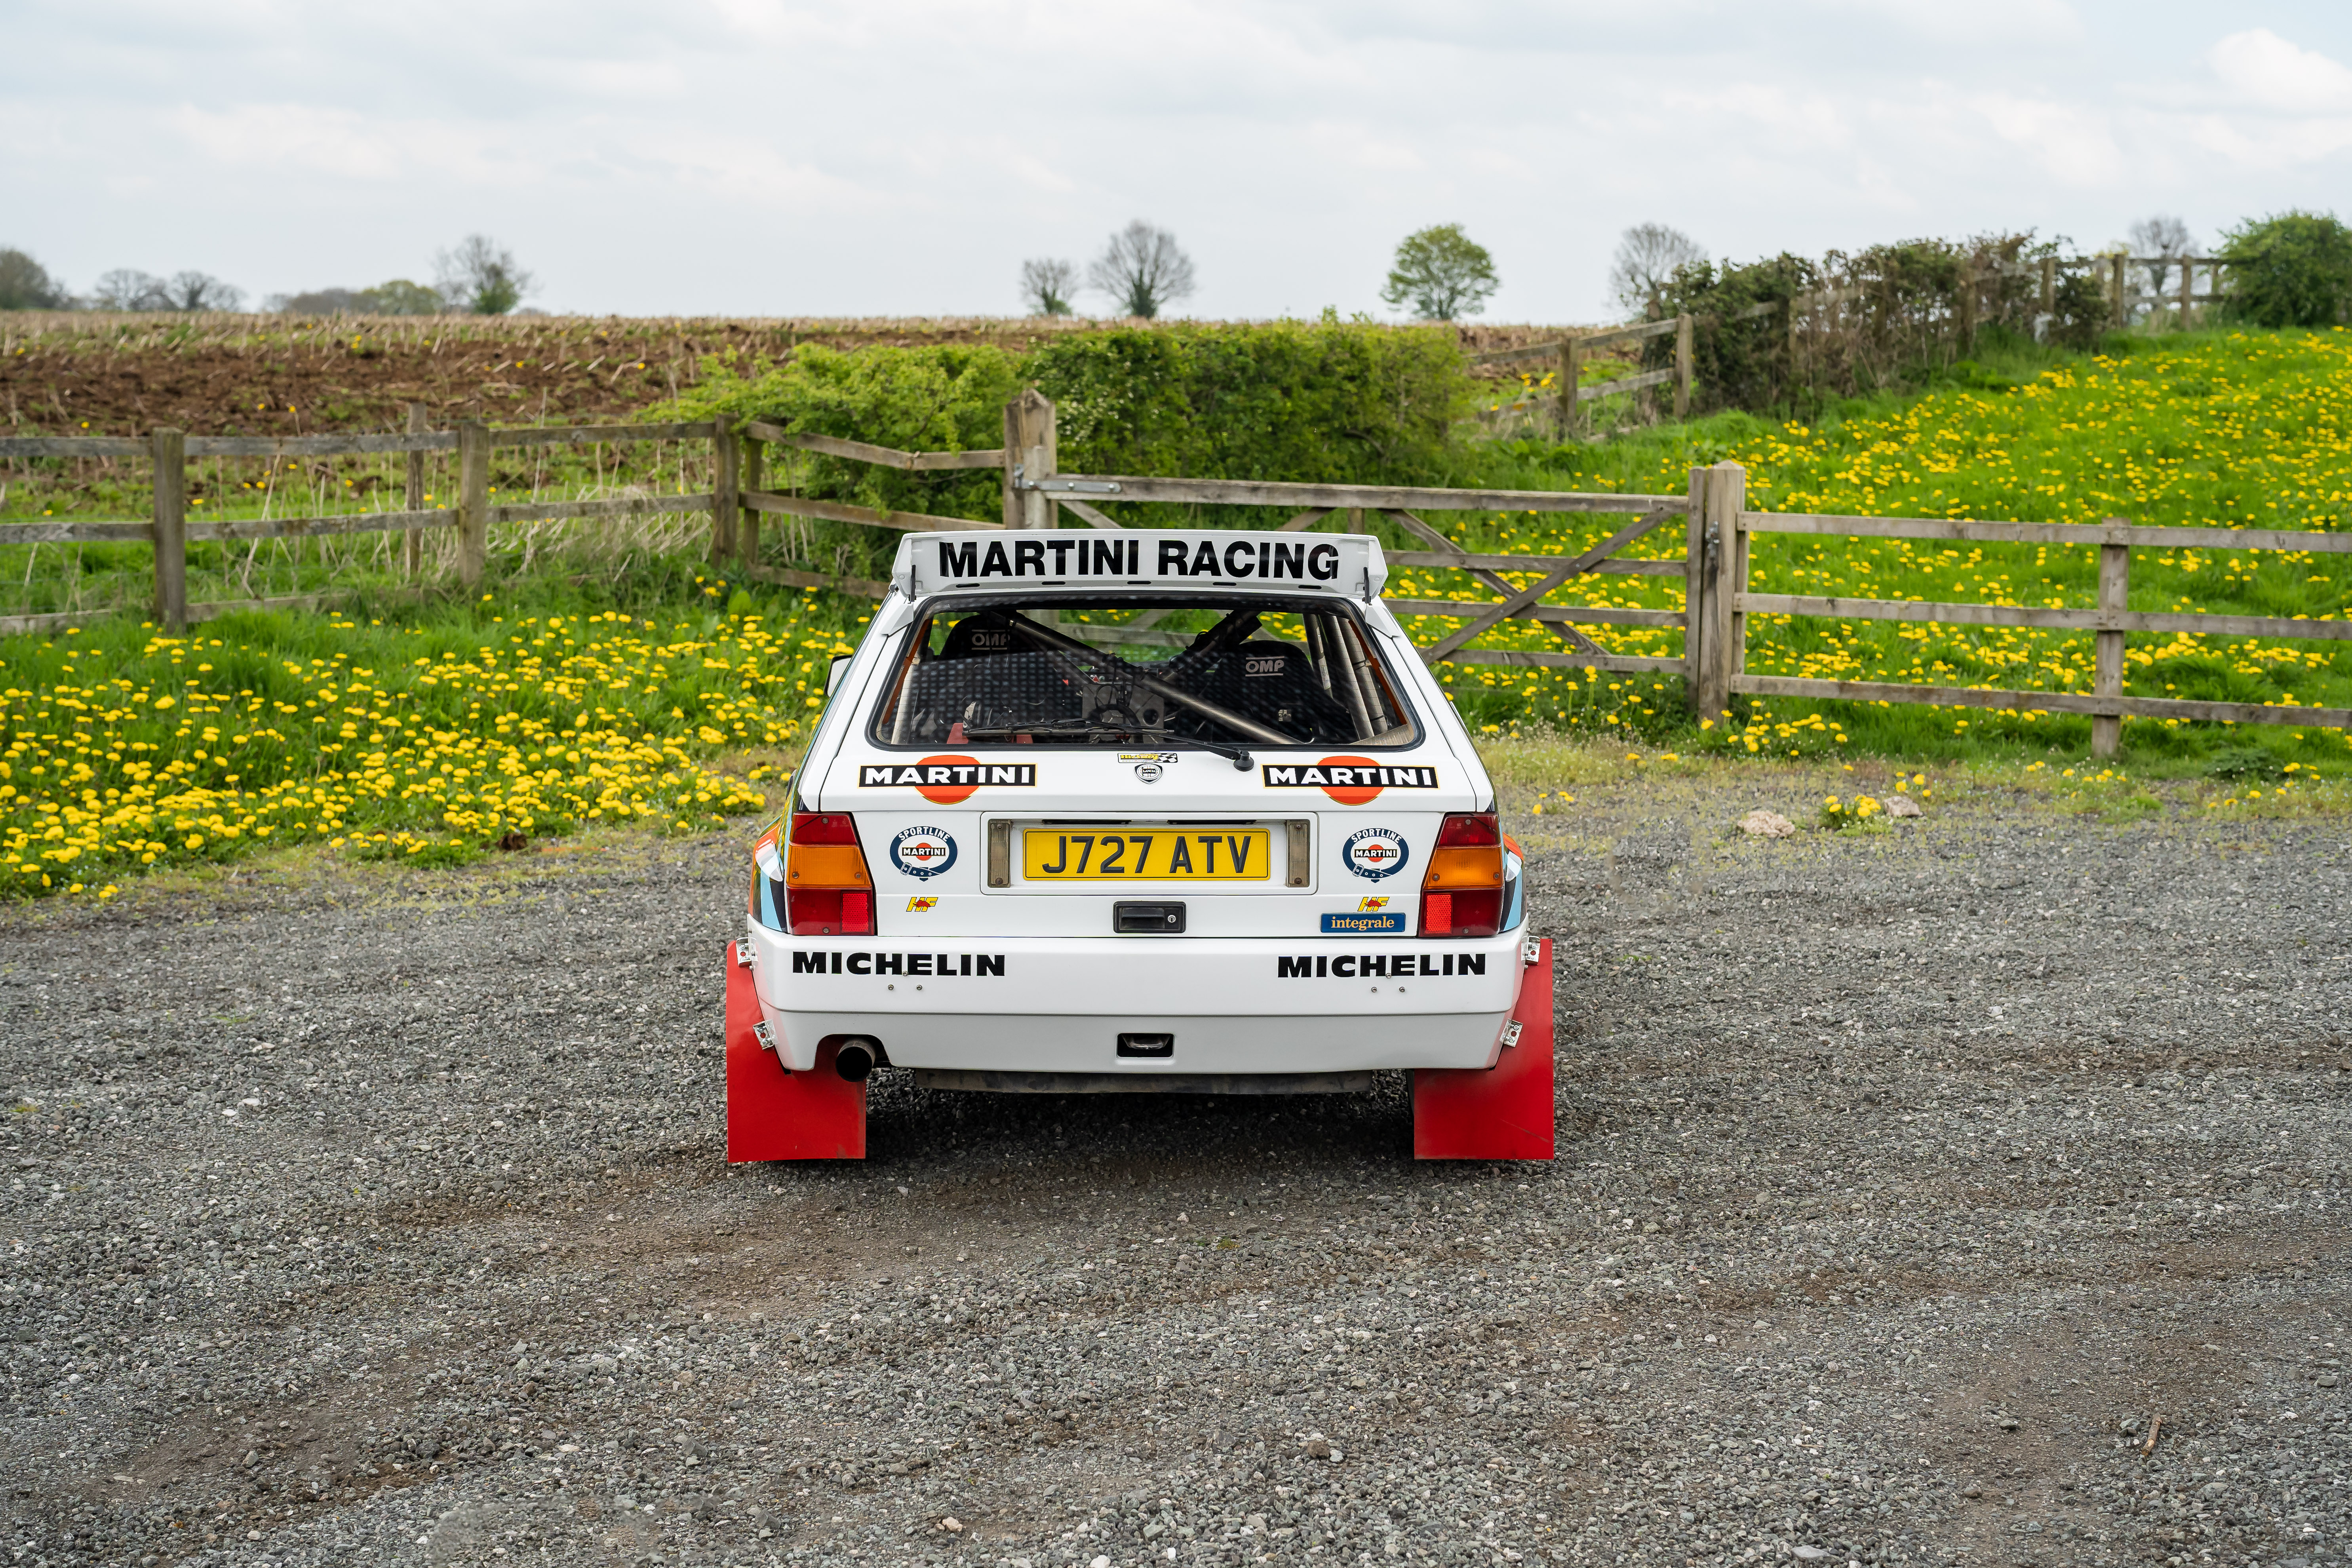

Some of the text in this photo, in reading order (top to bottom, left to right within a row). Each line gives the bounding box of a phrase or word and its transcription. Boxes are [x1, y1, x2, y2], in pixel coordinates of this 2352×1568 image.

[940, 539, 1339, 580] MARTINI RACING
[972, 634, 1010, 645] OMP
[1245, 659, 1284, 674] OMP
[865, 766, 1030, 784] MARTINI
[1269, 767, 1432, 786] MARTINI
[898, 826, 950, 843] SPORTLINE
[1351, 828, 1402, 844] SPORTLINE
[903, 848, 946, 856] MARTINI
[1042, 836, 1250, 873] J727 ATV
[1355, 849, 1397, 858] MARTINI
[906, 897, 939, 912] HF
[1357, 896, 1390, 912] HF
[1331, 916, 1395, 931] integrale
[792, 951, 1005, 976] MICHELIN
[1277, 953, 1486, 978] MICHELIN
